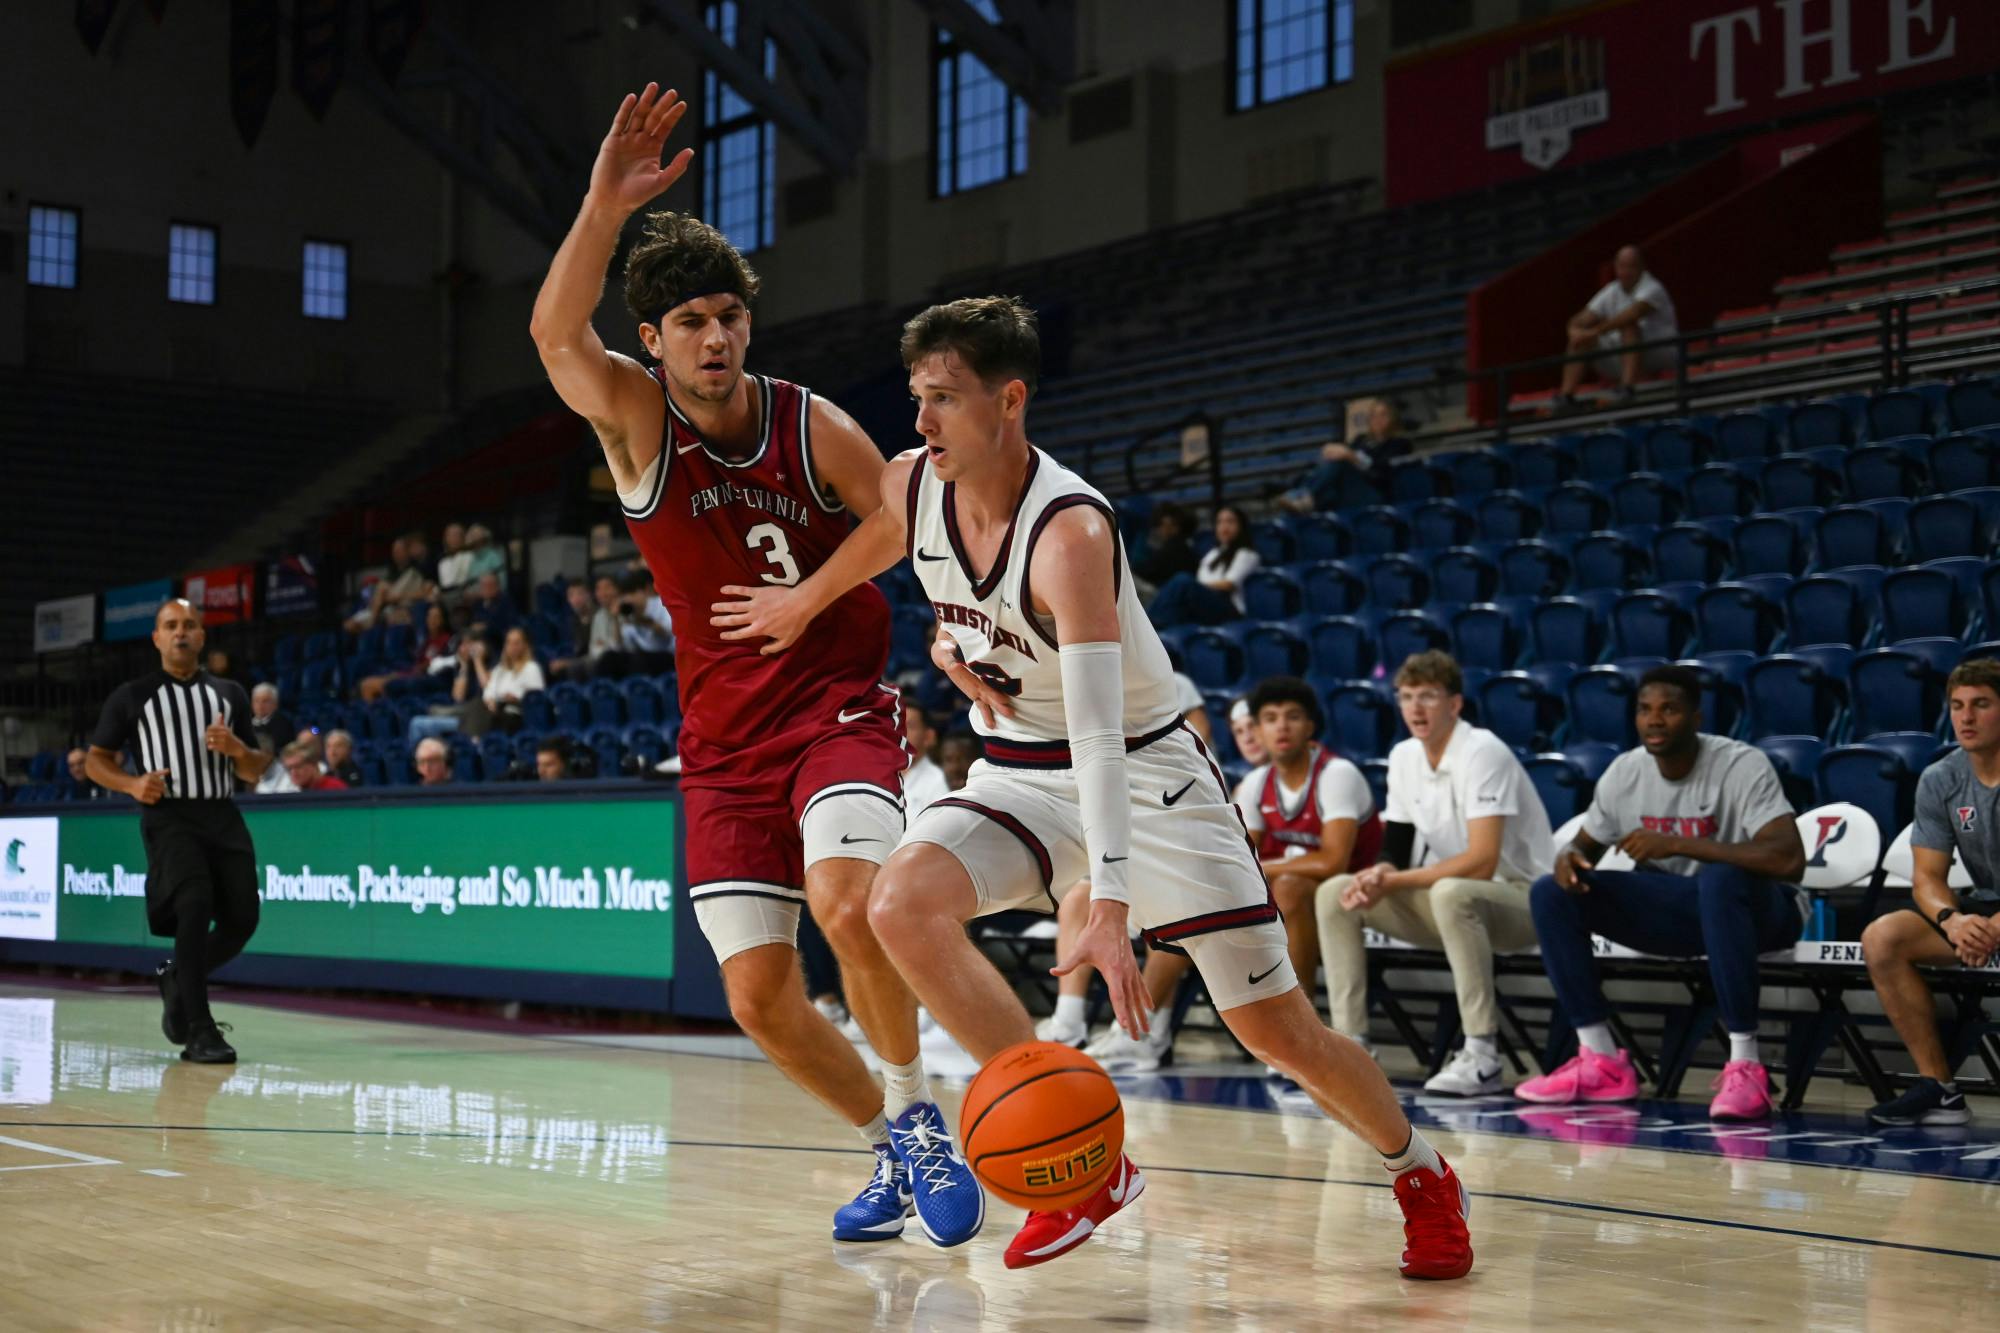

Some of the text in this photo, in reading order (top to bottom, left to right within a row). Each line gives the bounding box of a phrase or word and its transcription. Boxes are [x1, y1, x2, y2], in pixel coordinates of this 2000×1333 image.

[1690, 0, 1956, 115] THE
[690, 481, 809, 527] PENNLVANIA
[745, 522, 801, 586] 3
[63, 863, 147, 902] Posters, Bann
[265, 864, 356, 909] Brochures,
[357, 864, 456, 915] Packaging
[458, 865, 499, 906] and
[502, 865, 531, 907] So
[534, 866, 600, 909] Much
[604, 867, 672, 912] More
[1023, 1142, 1107, 1187] ELITE
